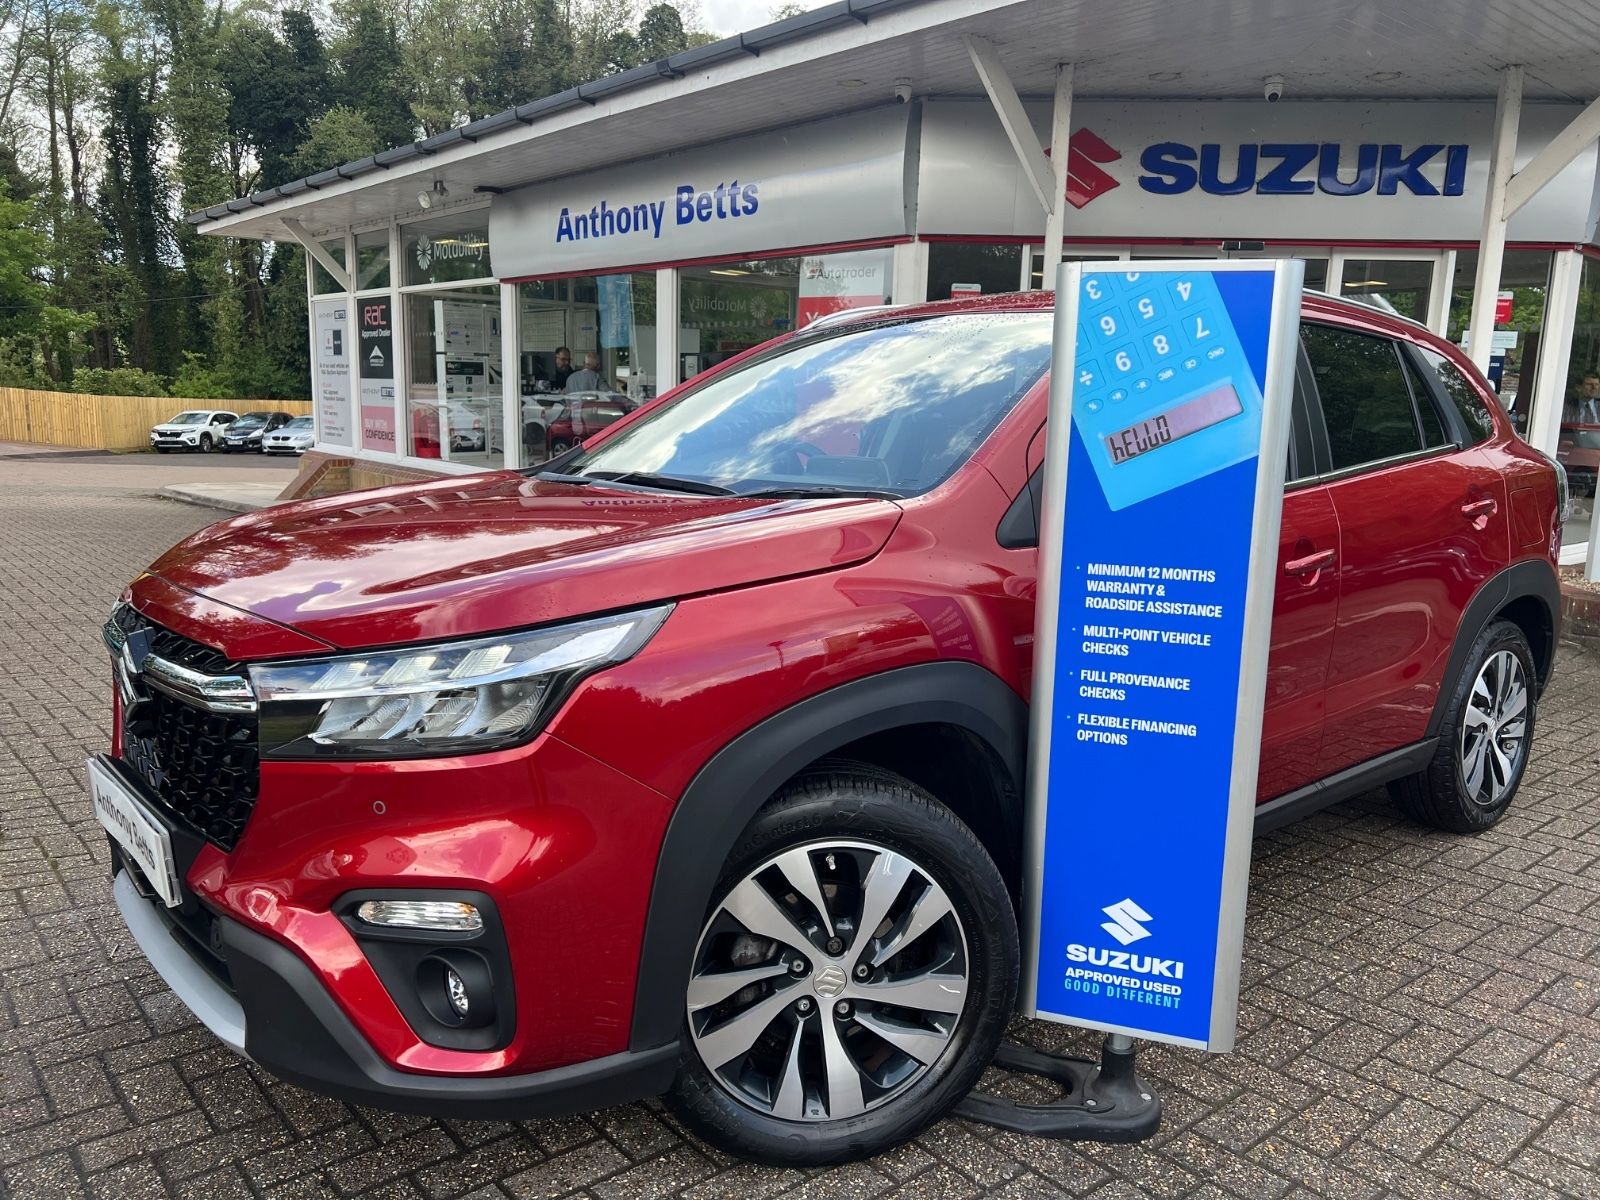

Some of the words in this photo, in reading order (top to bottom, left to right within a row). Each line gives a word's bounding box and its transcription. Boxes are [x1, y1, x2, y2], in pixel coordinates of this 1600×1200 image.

[1138, 141, 1469, 196] SUZUKI
[556, 199, 665, 243] Anthony
[676, 180, 759, 226] Betts
[434, 232, 485, 261] Motability
[816, 266, 876, 280] Autotrader
[1085, 280, 1102, 300] 3
[1176, 281, 1192, 301] 4
[1138, 298, 1155, 319] 5
[1100, 316, 1116, 336] 6
[1195, 317, 1211, 339] 7
[1152, 334, 1169, 355] 8
[1115, 351, 1131, 371] 9
[365, 429, 395, 442] CONFIDENCE
[1087, 563, 1145, 578] MINIMUM
[1147, 566, 1160, 578] 12
[1162, 568, 1216, 583] MONTHS
[1086, 580, 1155, 596] WARRANTY
[1156, 584, 1165, 597] &
[1085, 596, 1144, 612] ROADSIDE
[1146, 600, 1222, 618] ASSISTANCE
[1083, 624, 1160, 642] MULTI-POINT
[1161, 631, 1211, 646] VEHICLE
[1082, 641, 1129, 656] CHECKS
[1080, 669, 1108, 683] FULL
[1109, 671, 1191, 691] PROVENANCE
[1079, 685, 1126, 701] CHECKS
[1077, 713, 1129, 730] FLEXIBLE
[1131, 718, 1197, 737] FINANCING
[1076, 729, 1128, 746] OPTIONS
[96, 783, 134, 846] Anthony
[131, 820, 156, 870] Betts
[1066, 943, 1184, 979] SUZUKI
[1065, 966, 1141, 989] APPROVED
[1143, 980, 1182, 996] USED
[1064, 978, 1100, 995] GOOD
[1107, 985, 1181, 1009] DIFFERENT
